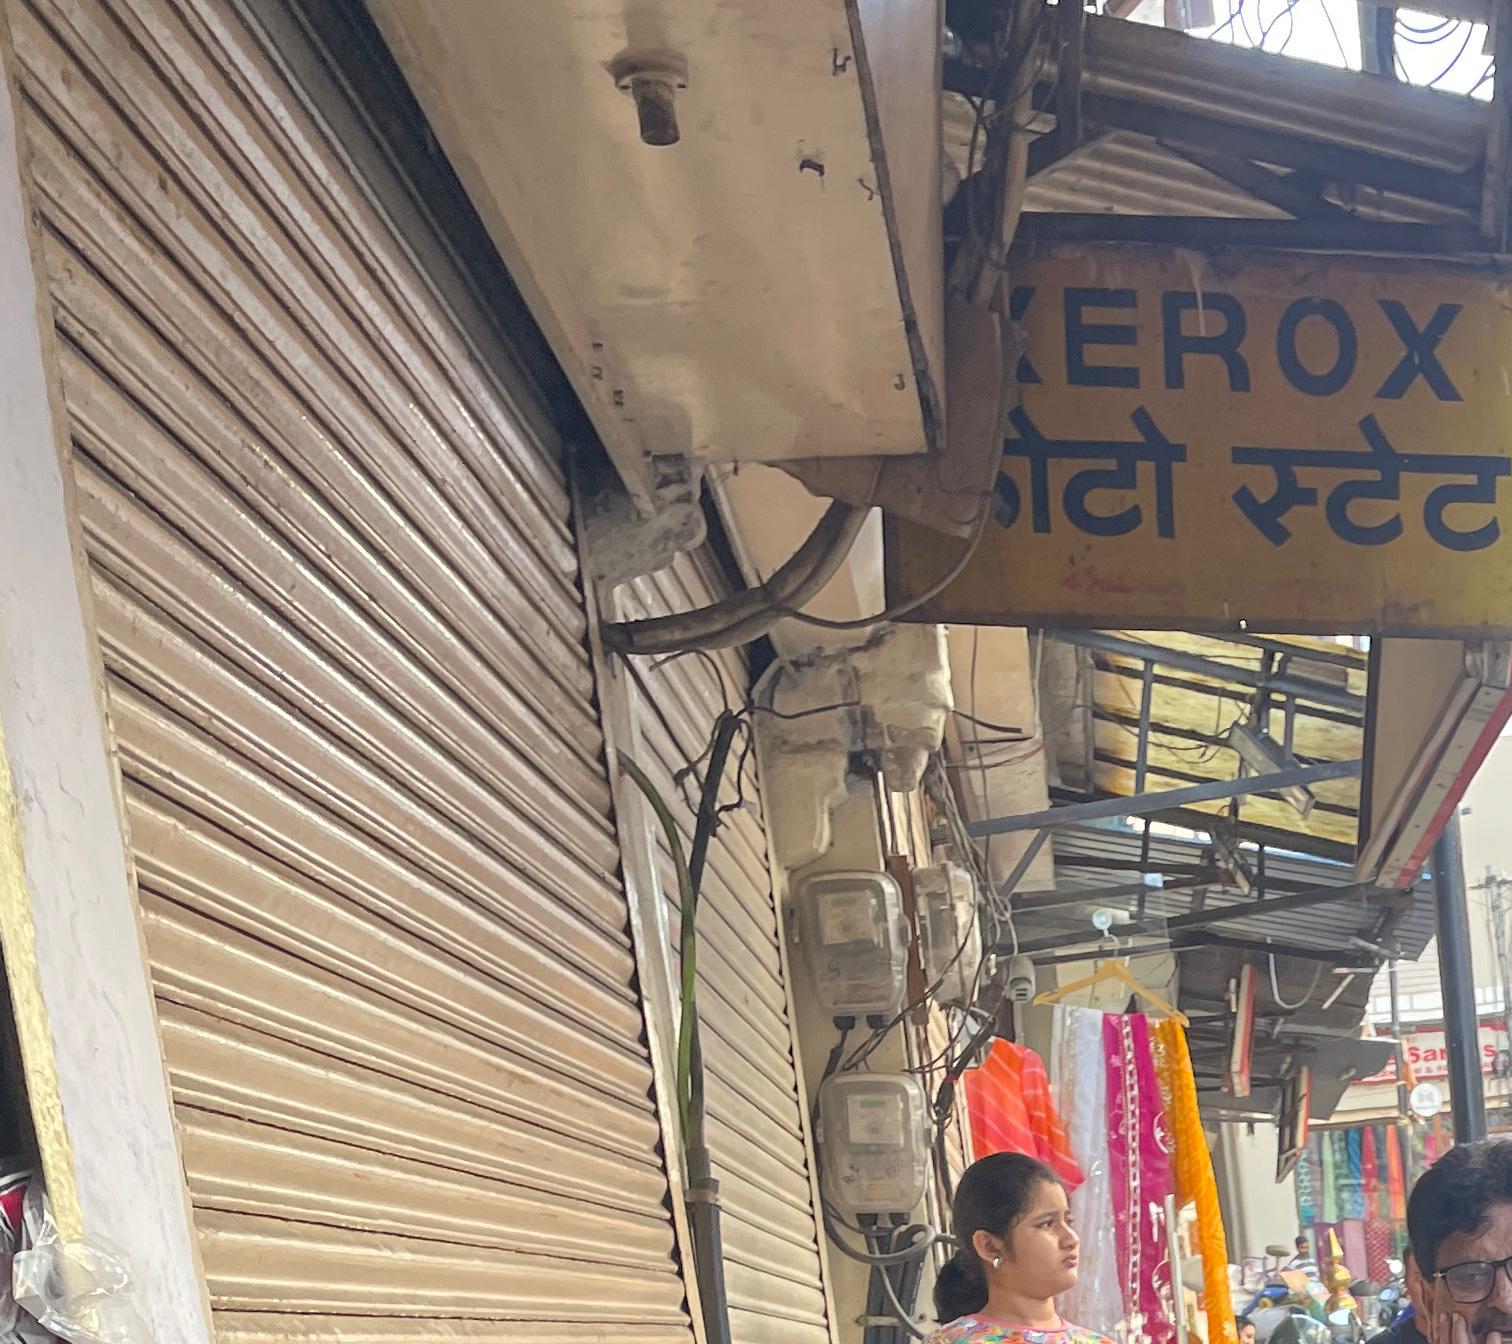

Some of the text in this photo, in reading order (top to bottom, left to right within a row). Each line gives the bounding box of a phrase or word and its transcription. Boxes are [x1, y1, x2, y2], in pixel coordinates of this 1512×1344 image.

[994, 405, 1187, 540] ोटो
[1231, 413, 1512, 552] स्टेट
[1408, 1044, 1497, 1064] Sars
